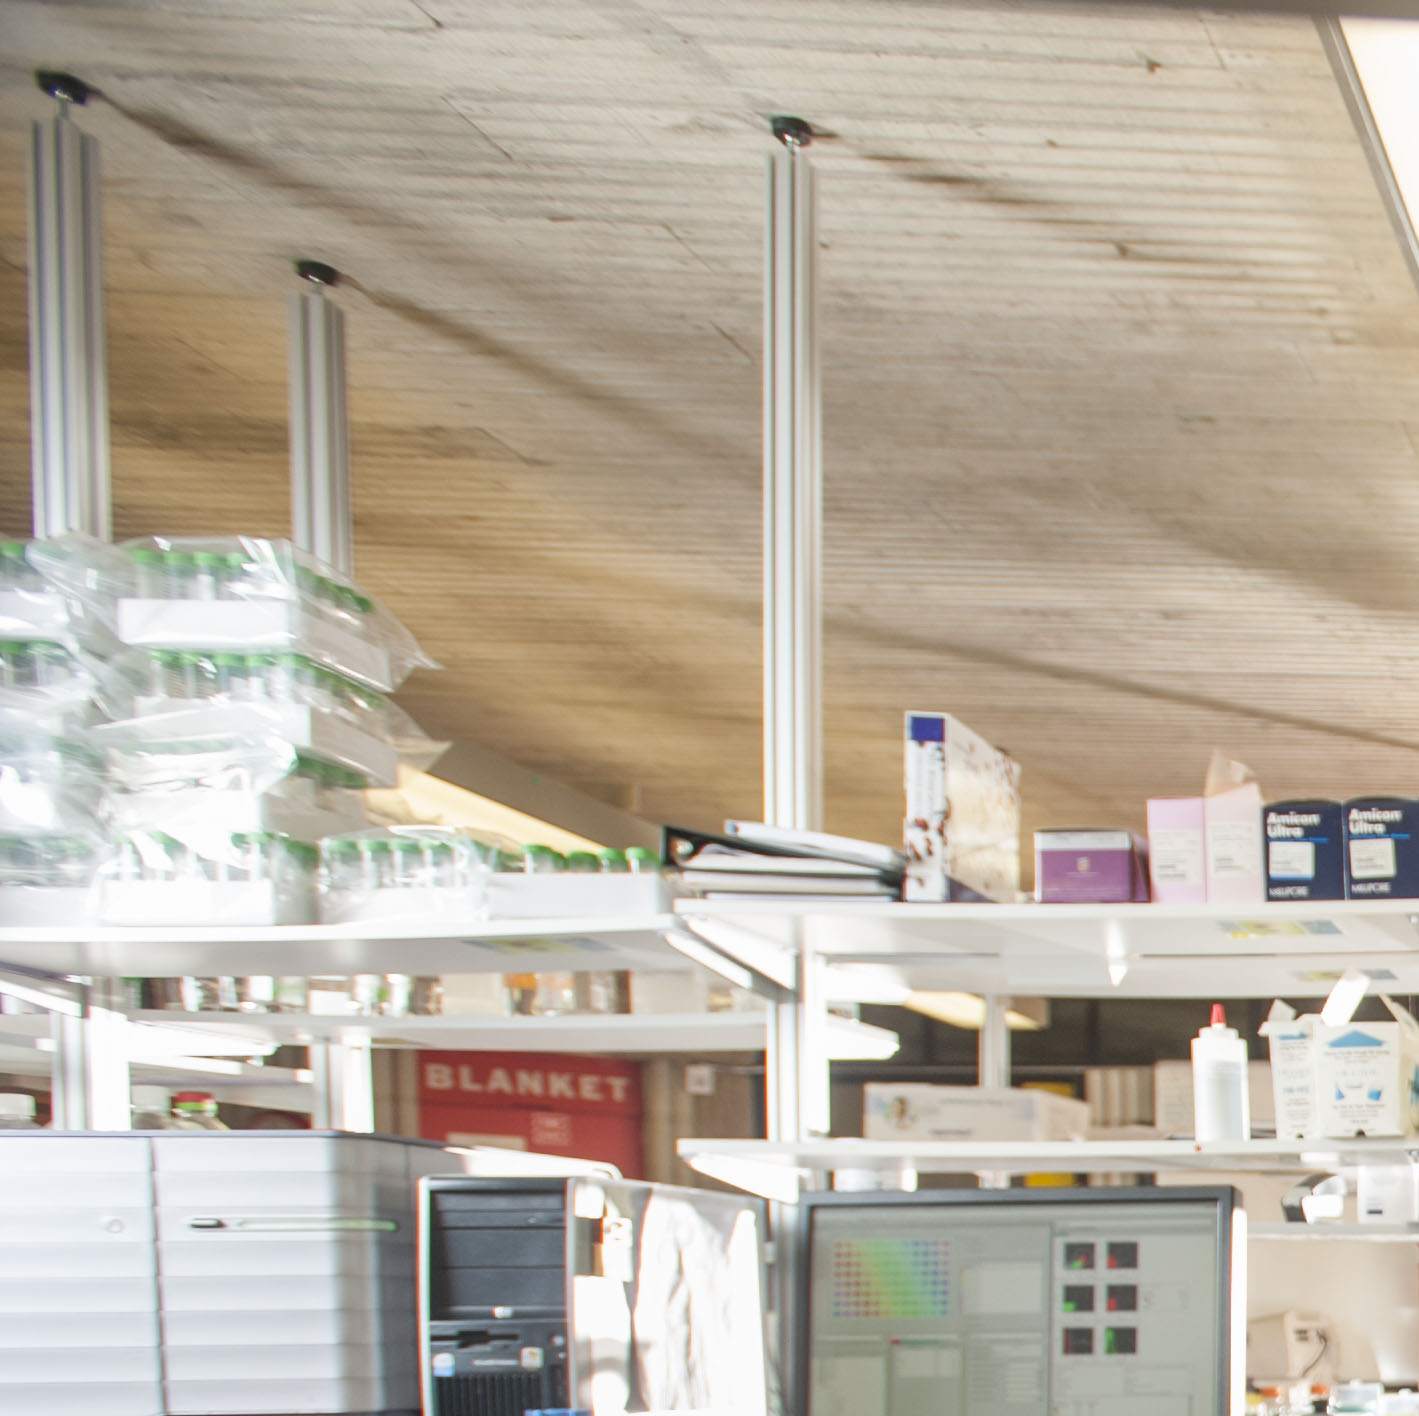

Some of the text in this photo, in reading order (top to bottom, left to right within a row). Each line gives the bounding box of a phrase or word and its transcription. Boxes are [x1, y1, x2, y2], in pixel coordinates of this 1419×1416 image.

[1267, 811, 1321, 826] Amicon
[1349, 808, 1403, 822] Amicon
[1267, 824, 1304, 838] Ultra
[1349, 821, 1387, 835] Ultra
[424, 1063, 630, 1101] BLANKET
